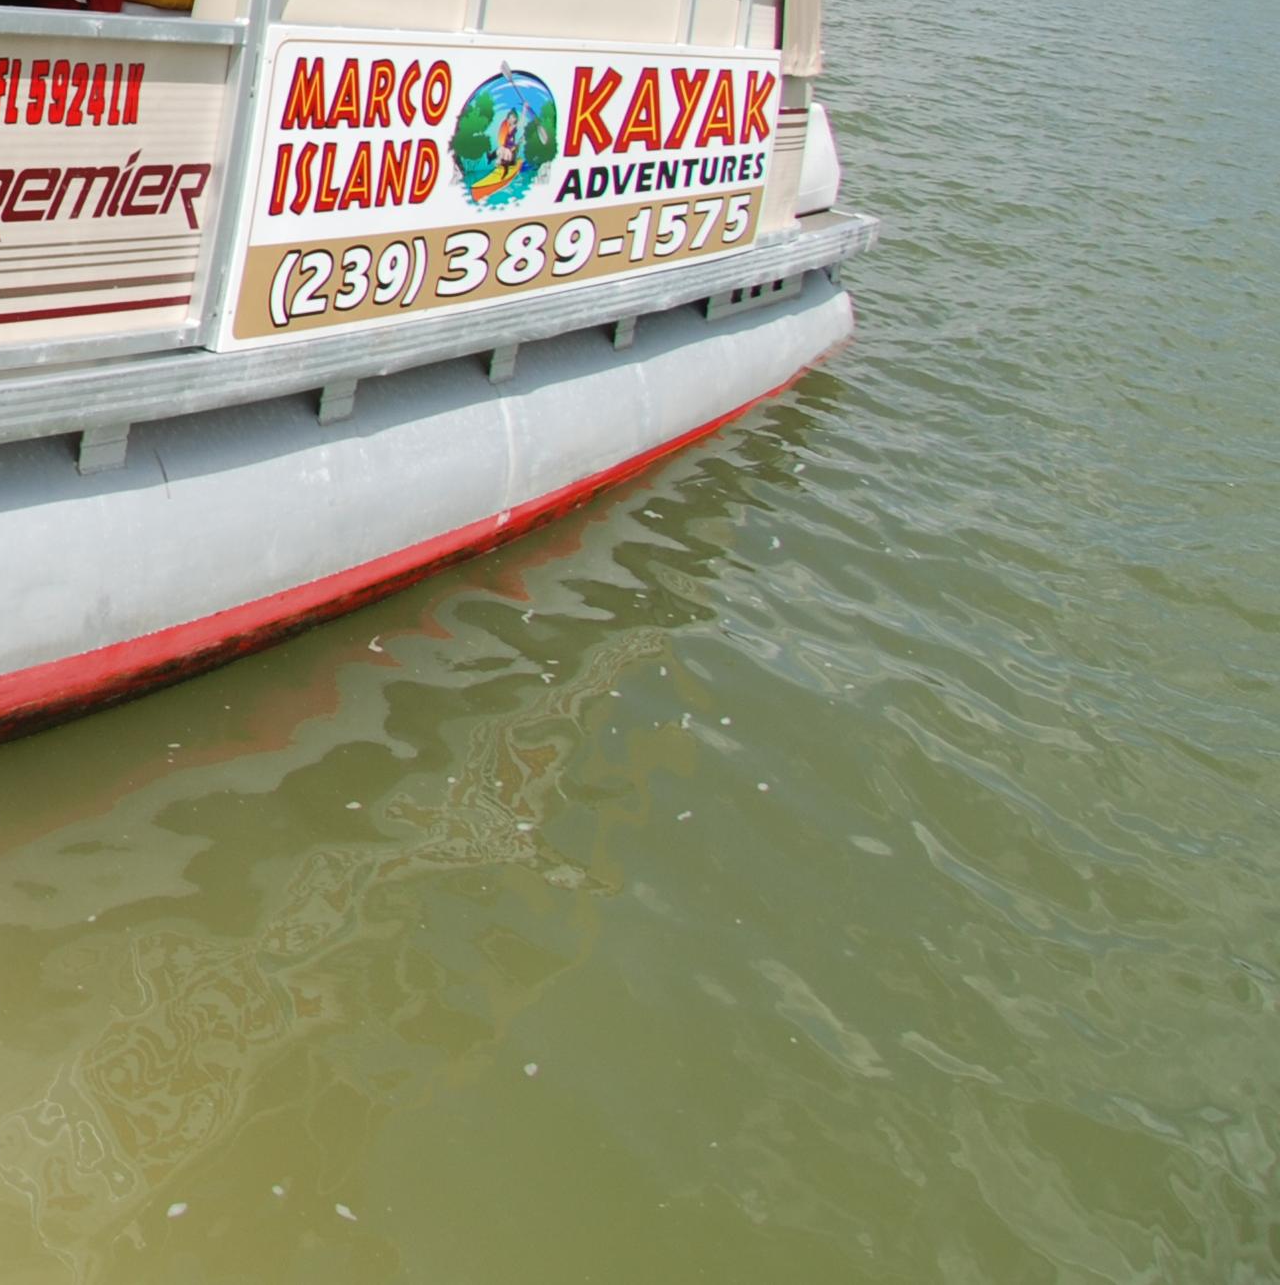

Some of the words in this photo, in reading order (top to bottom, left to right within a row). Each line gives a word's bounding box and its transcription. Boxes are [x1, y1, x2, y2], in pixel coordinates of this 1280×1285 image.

[281, 57, 452, 130] MARCO
[563, 66, 776, 157] KAYAK
[268, 139, 440, 216] ISLAND
[554, 152, 766, 203] ADVENTURES
[269, 236, 429, 328] (239)
[436, 193, 752, 297] 389-1575
